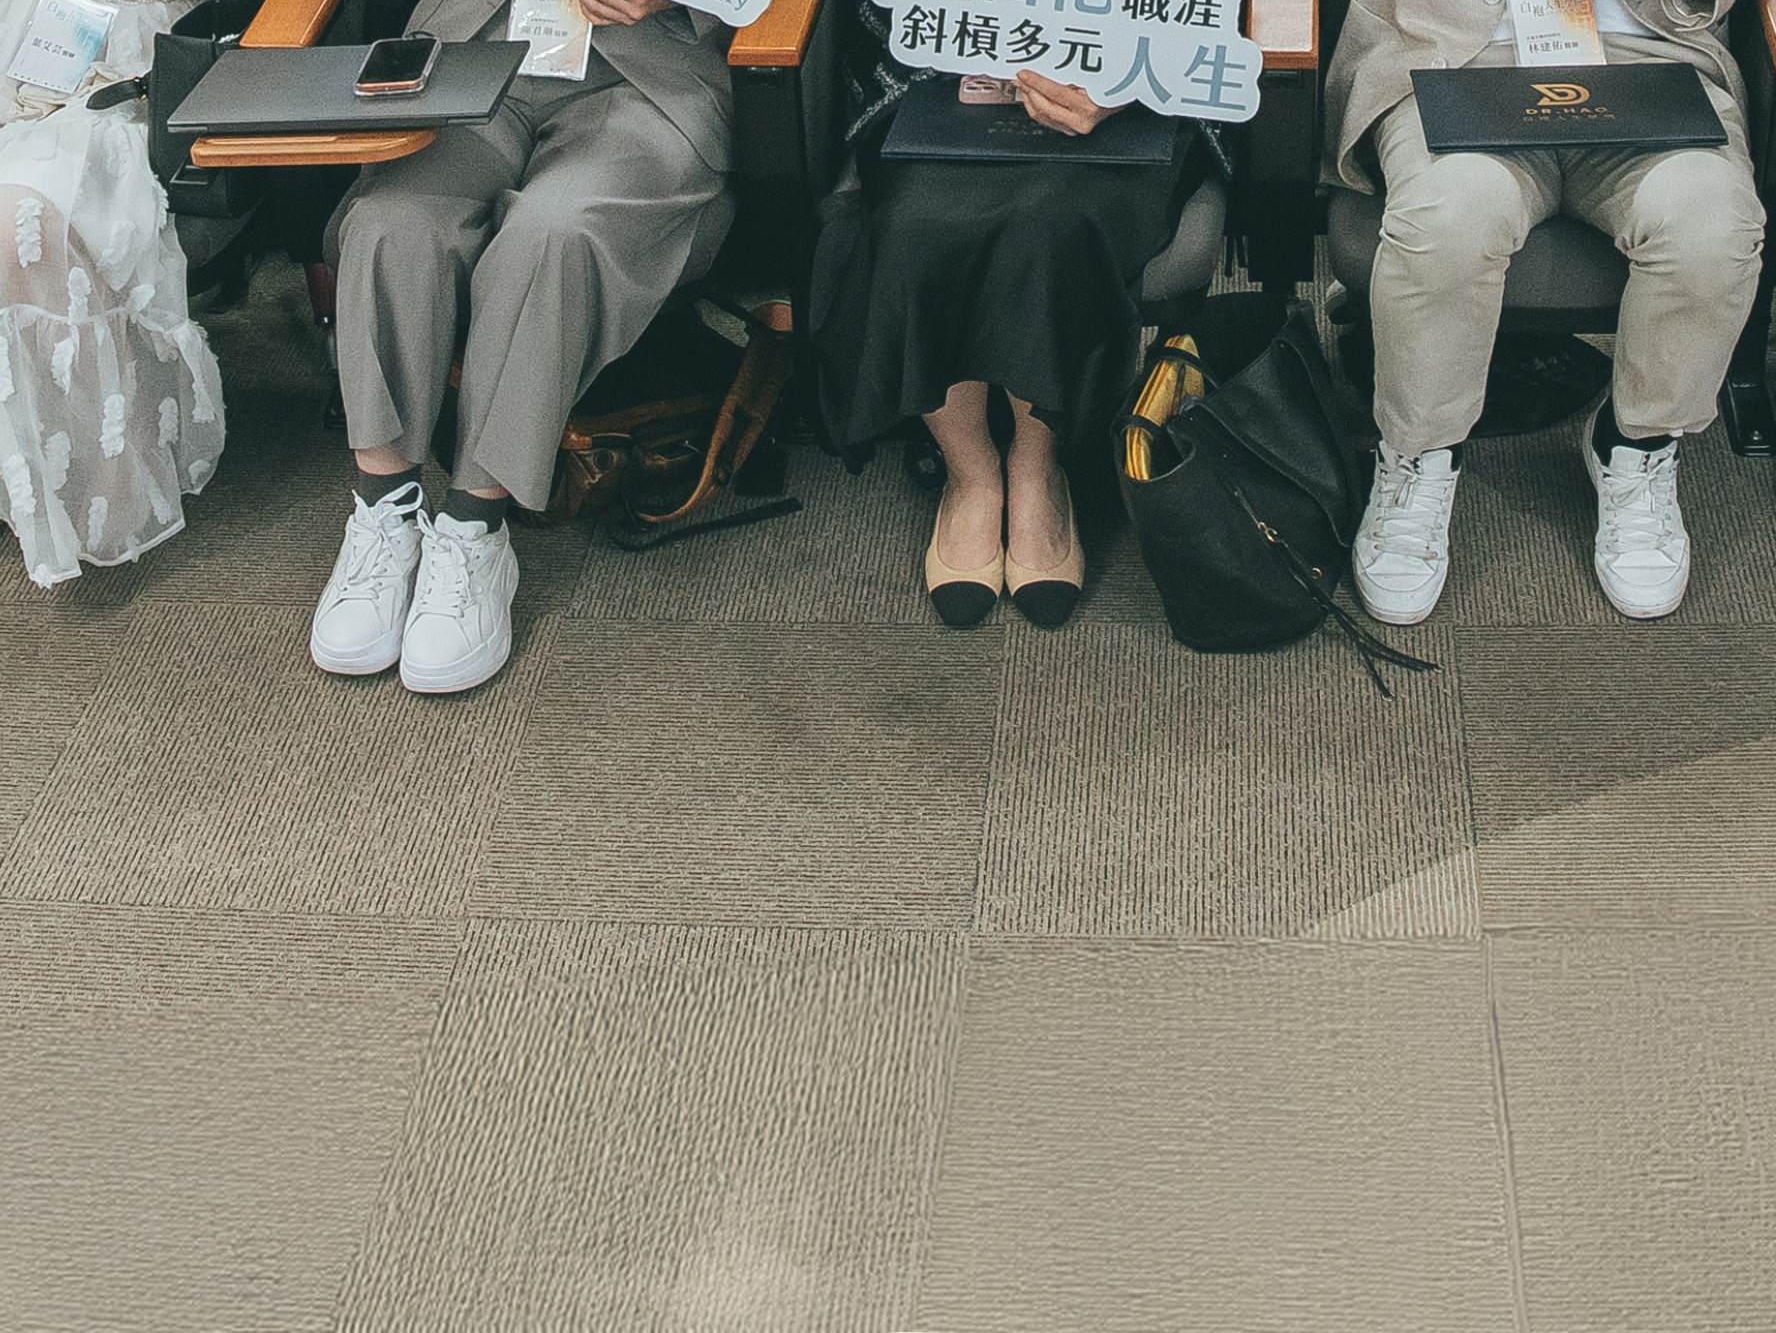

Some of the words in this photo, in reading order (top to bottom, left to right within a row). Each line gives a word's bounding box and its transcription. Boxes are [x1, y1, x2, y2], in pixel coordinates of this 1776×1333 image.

[899, 4, 1247, 111] 斜槓多元人生
